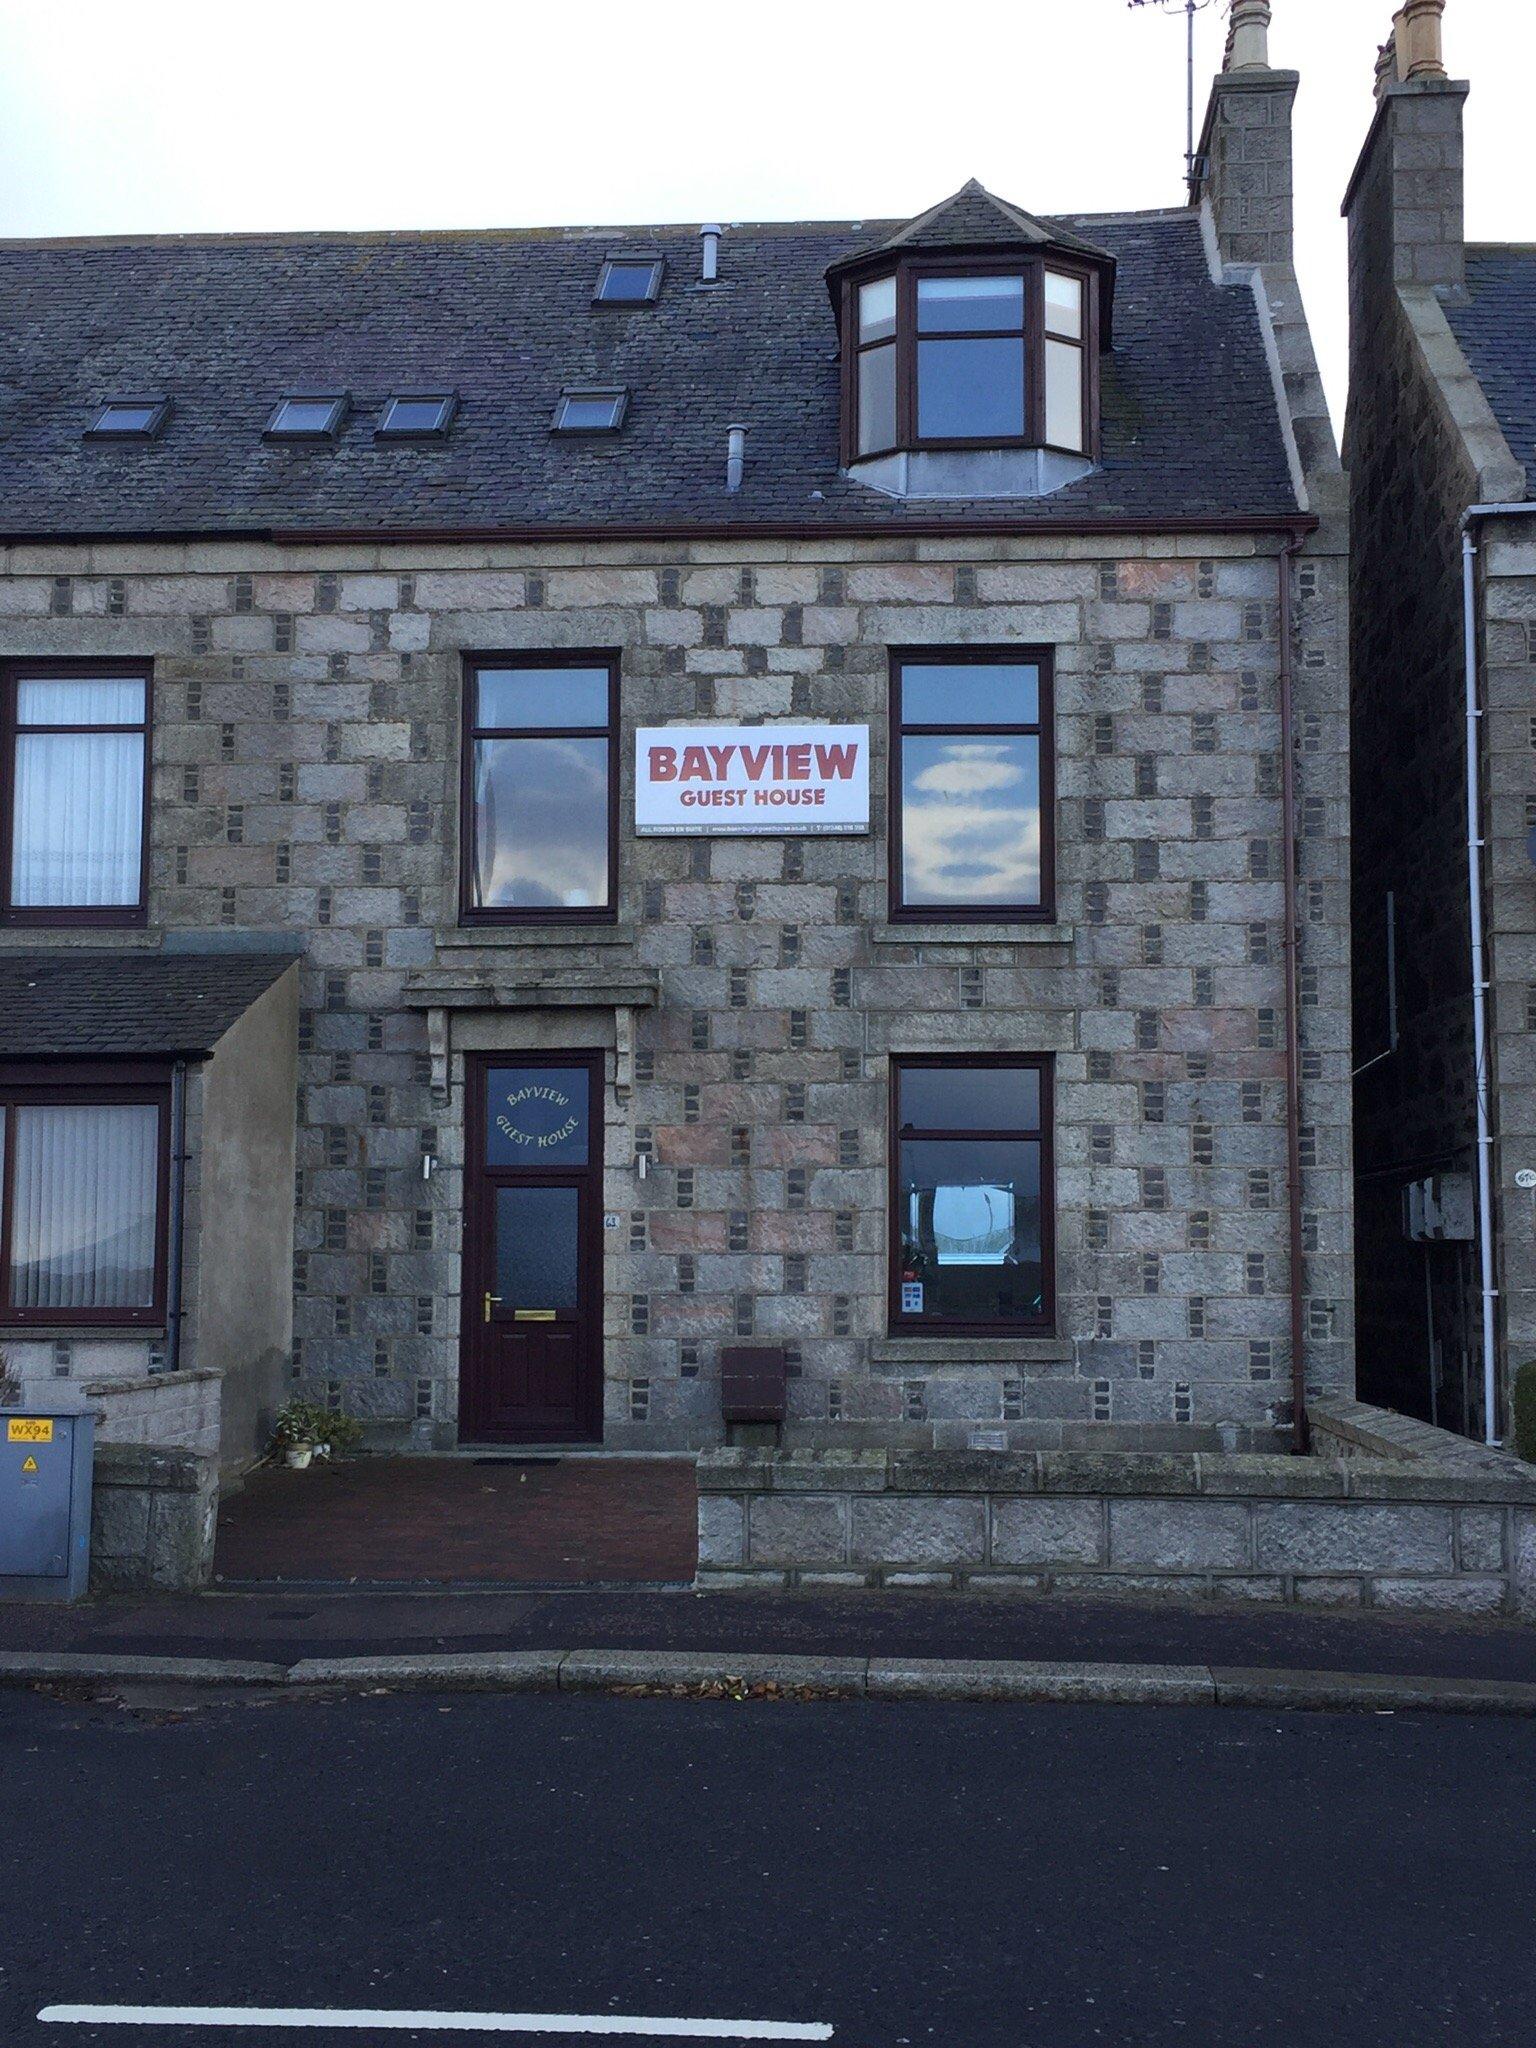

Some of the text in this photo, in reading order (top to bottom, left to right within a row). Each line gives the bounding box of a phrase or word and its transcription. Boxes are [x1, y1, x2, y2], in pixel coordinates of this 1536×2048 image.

[648, 743, 858, 782] BAYVIEW
[680, 788, 825, 806] GUEST HOUSE
[507, 1086, 569, 1106] BAYVIEW
[497, 1115, 579, 1148] GUEST HOUSE
[11, 1425, 50, 1435] WX94
